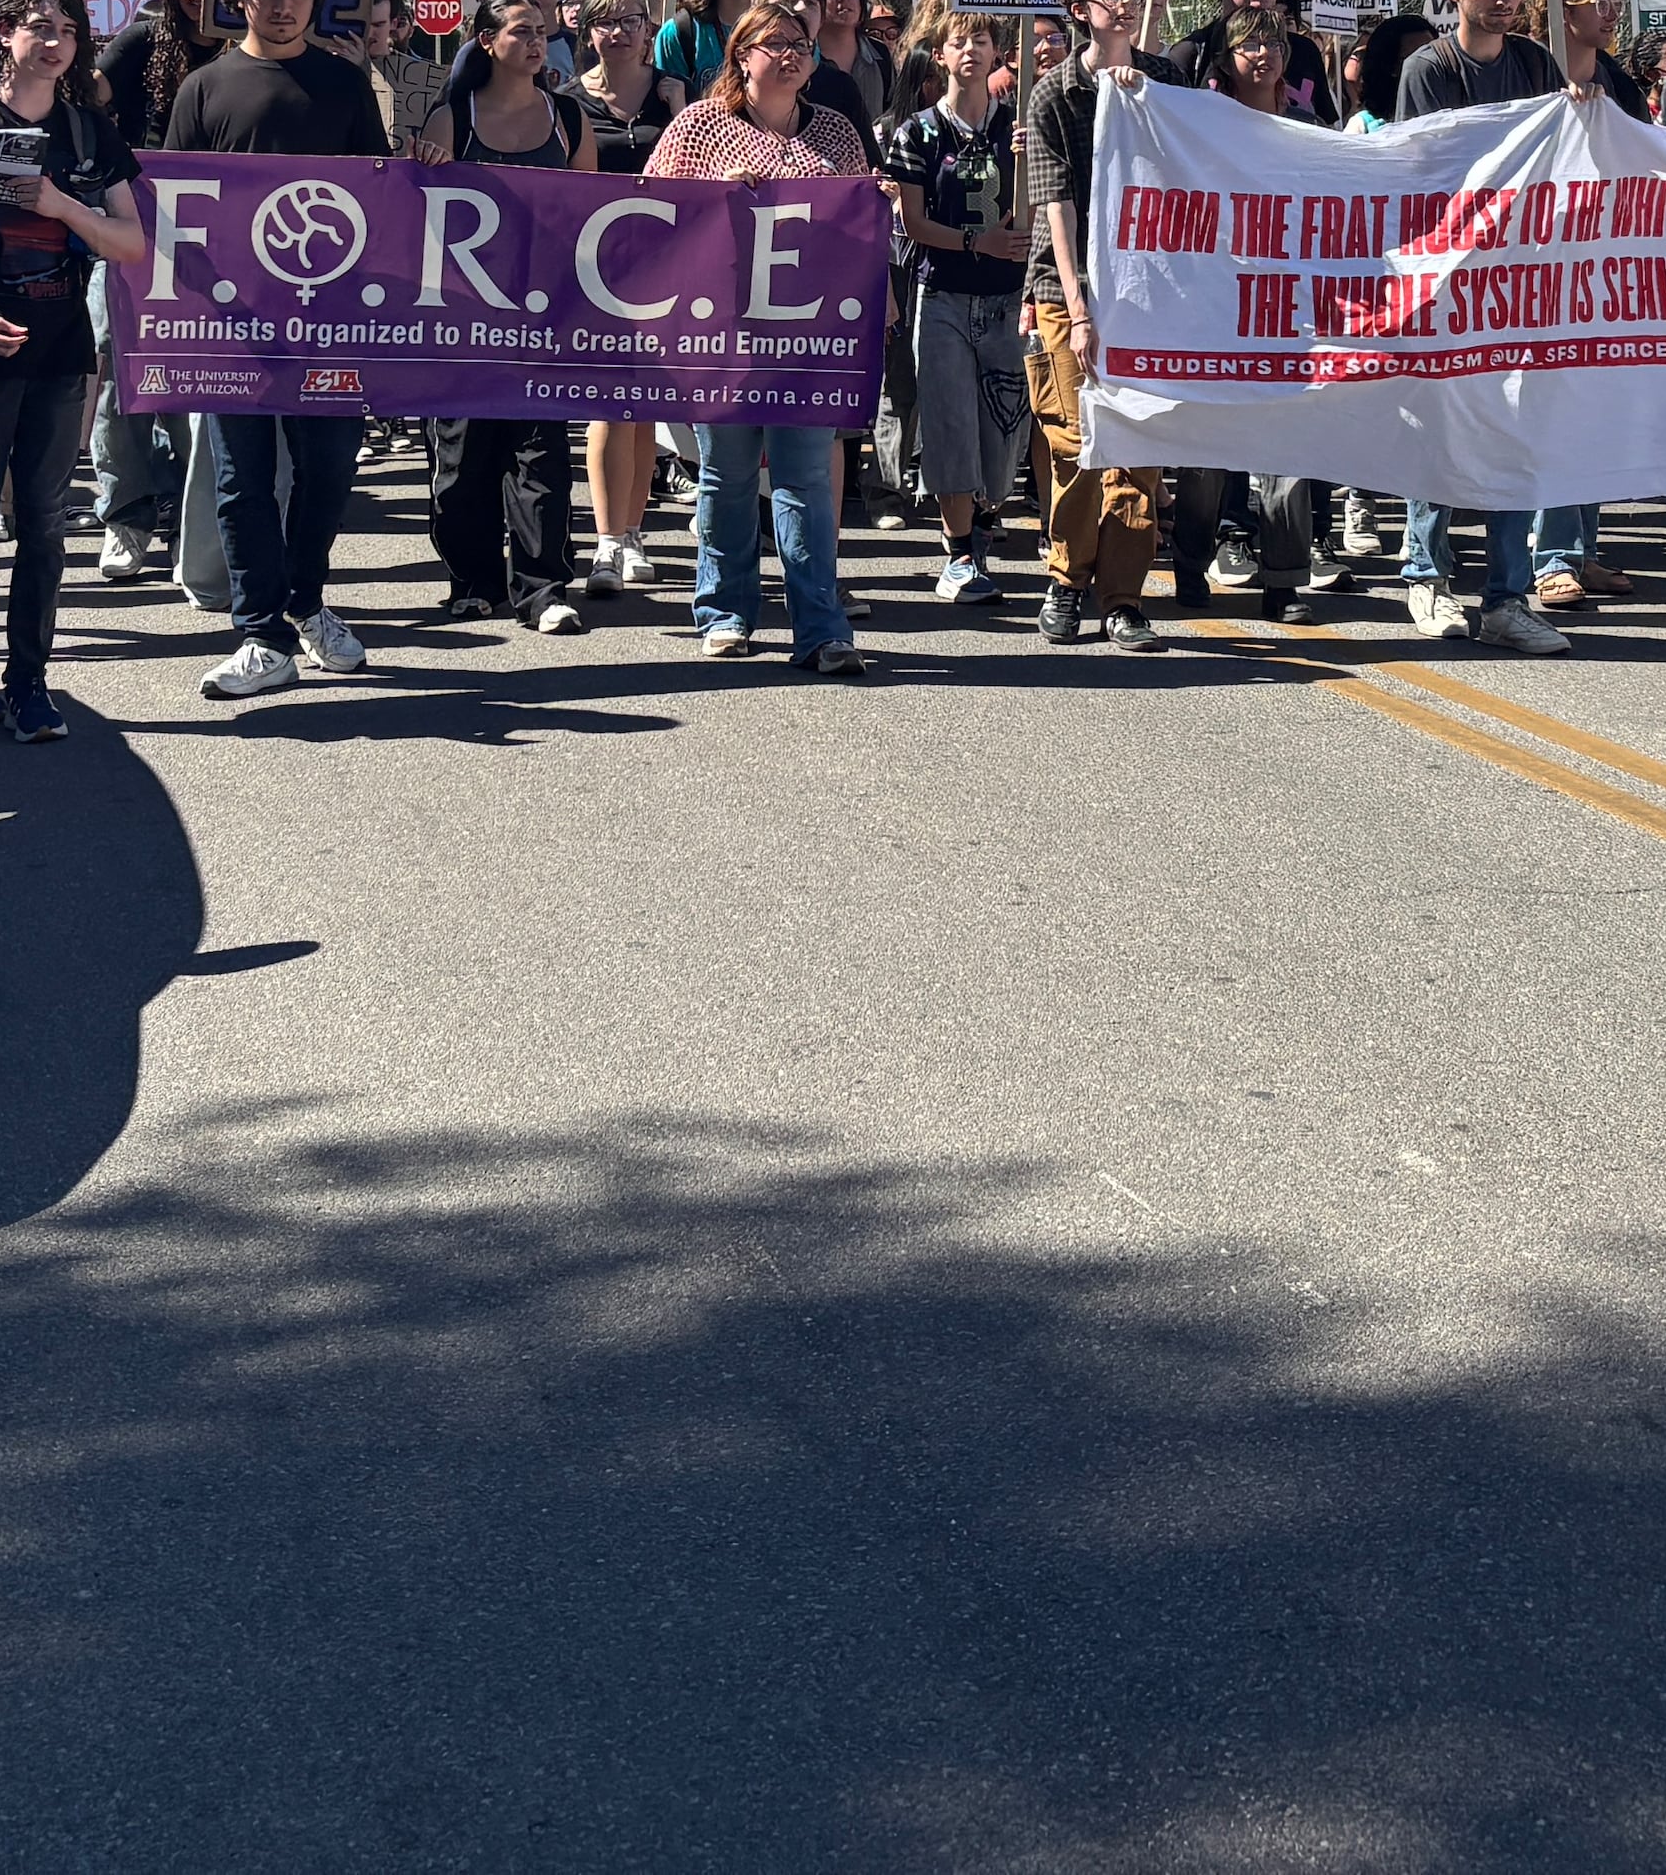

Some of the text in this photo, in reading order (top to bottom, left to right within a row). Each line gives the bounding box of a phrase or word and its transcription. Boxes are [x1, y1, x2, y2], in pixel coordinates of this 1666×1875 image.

[417, 1, 461, 19] STOP
[1117, 185, 1220, 254] FROM
[1230, 192, 1292, 259] THE
[1300, 195, 1389, 259] FRAT
[1398, 188, 1517, 256] HOUSE
[1520, 181, 1557, 245] TO
[1562, 179, 1611, 242] THE
[1237, 273, 1301, 338] THE
[1312, 272, 1439, 338] WHOLE
[1448, 261, 1563, 336] SYSTEM
[1569, 258, 1595, 324] IS
[139, 314, 859, 361] Feminists Organized to Resist, Create, and Empower
[169, 369, 261, 382] THE UNIVERSITY
[1134, 355, 1273, 377] STUDENTS
[1283, 357, 1337, 376] FOR
[1345, 352, 1482, 376] SOCIALISM
[1489, 345, 1578, 368] @UA_SFS
[301, 369, 363, 393] ASUA
[525, 379, 860, 407] force.asua.arizona.edu
